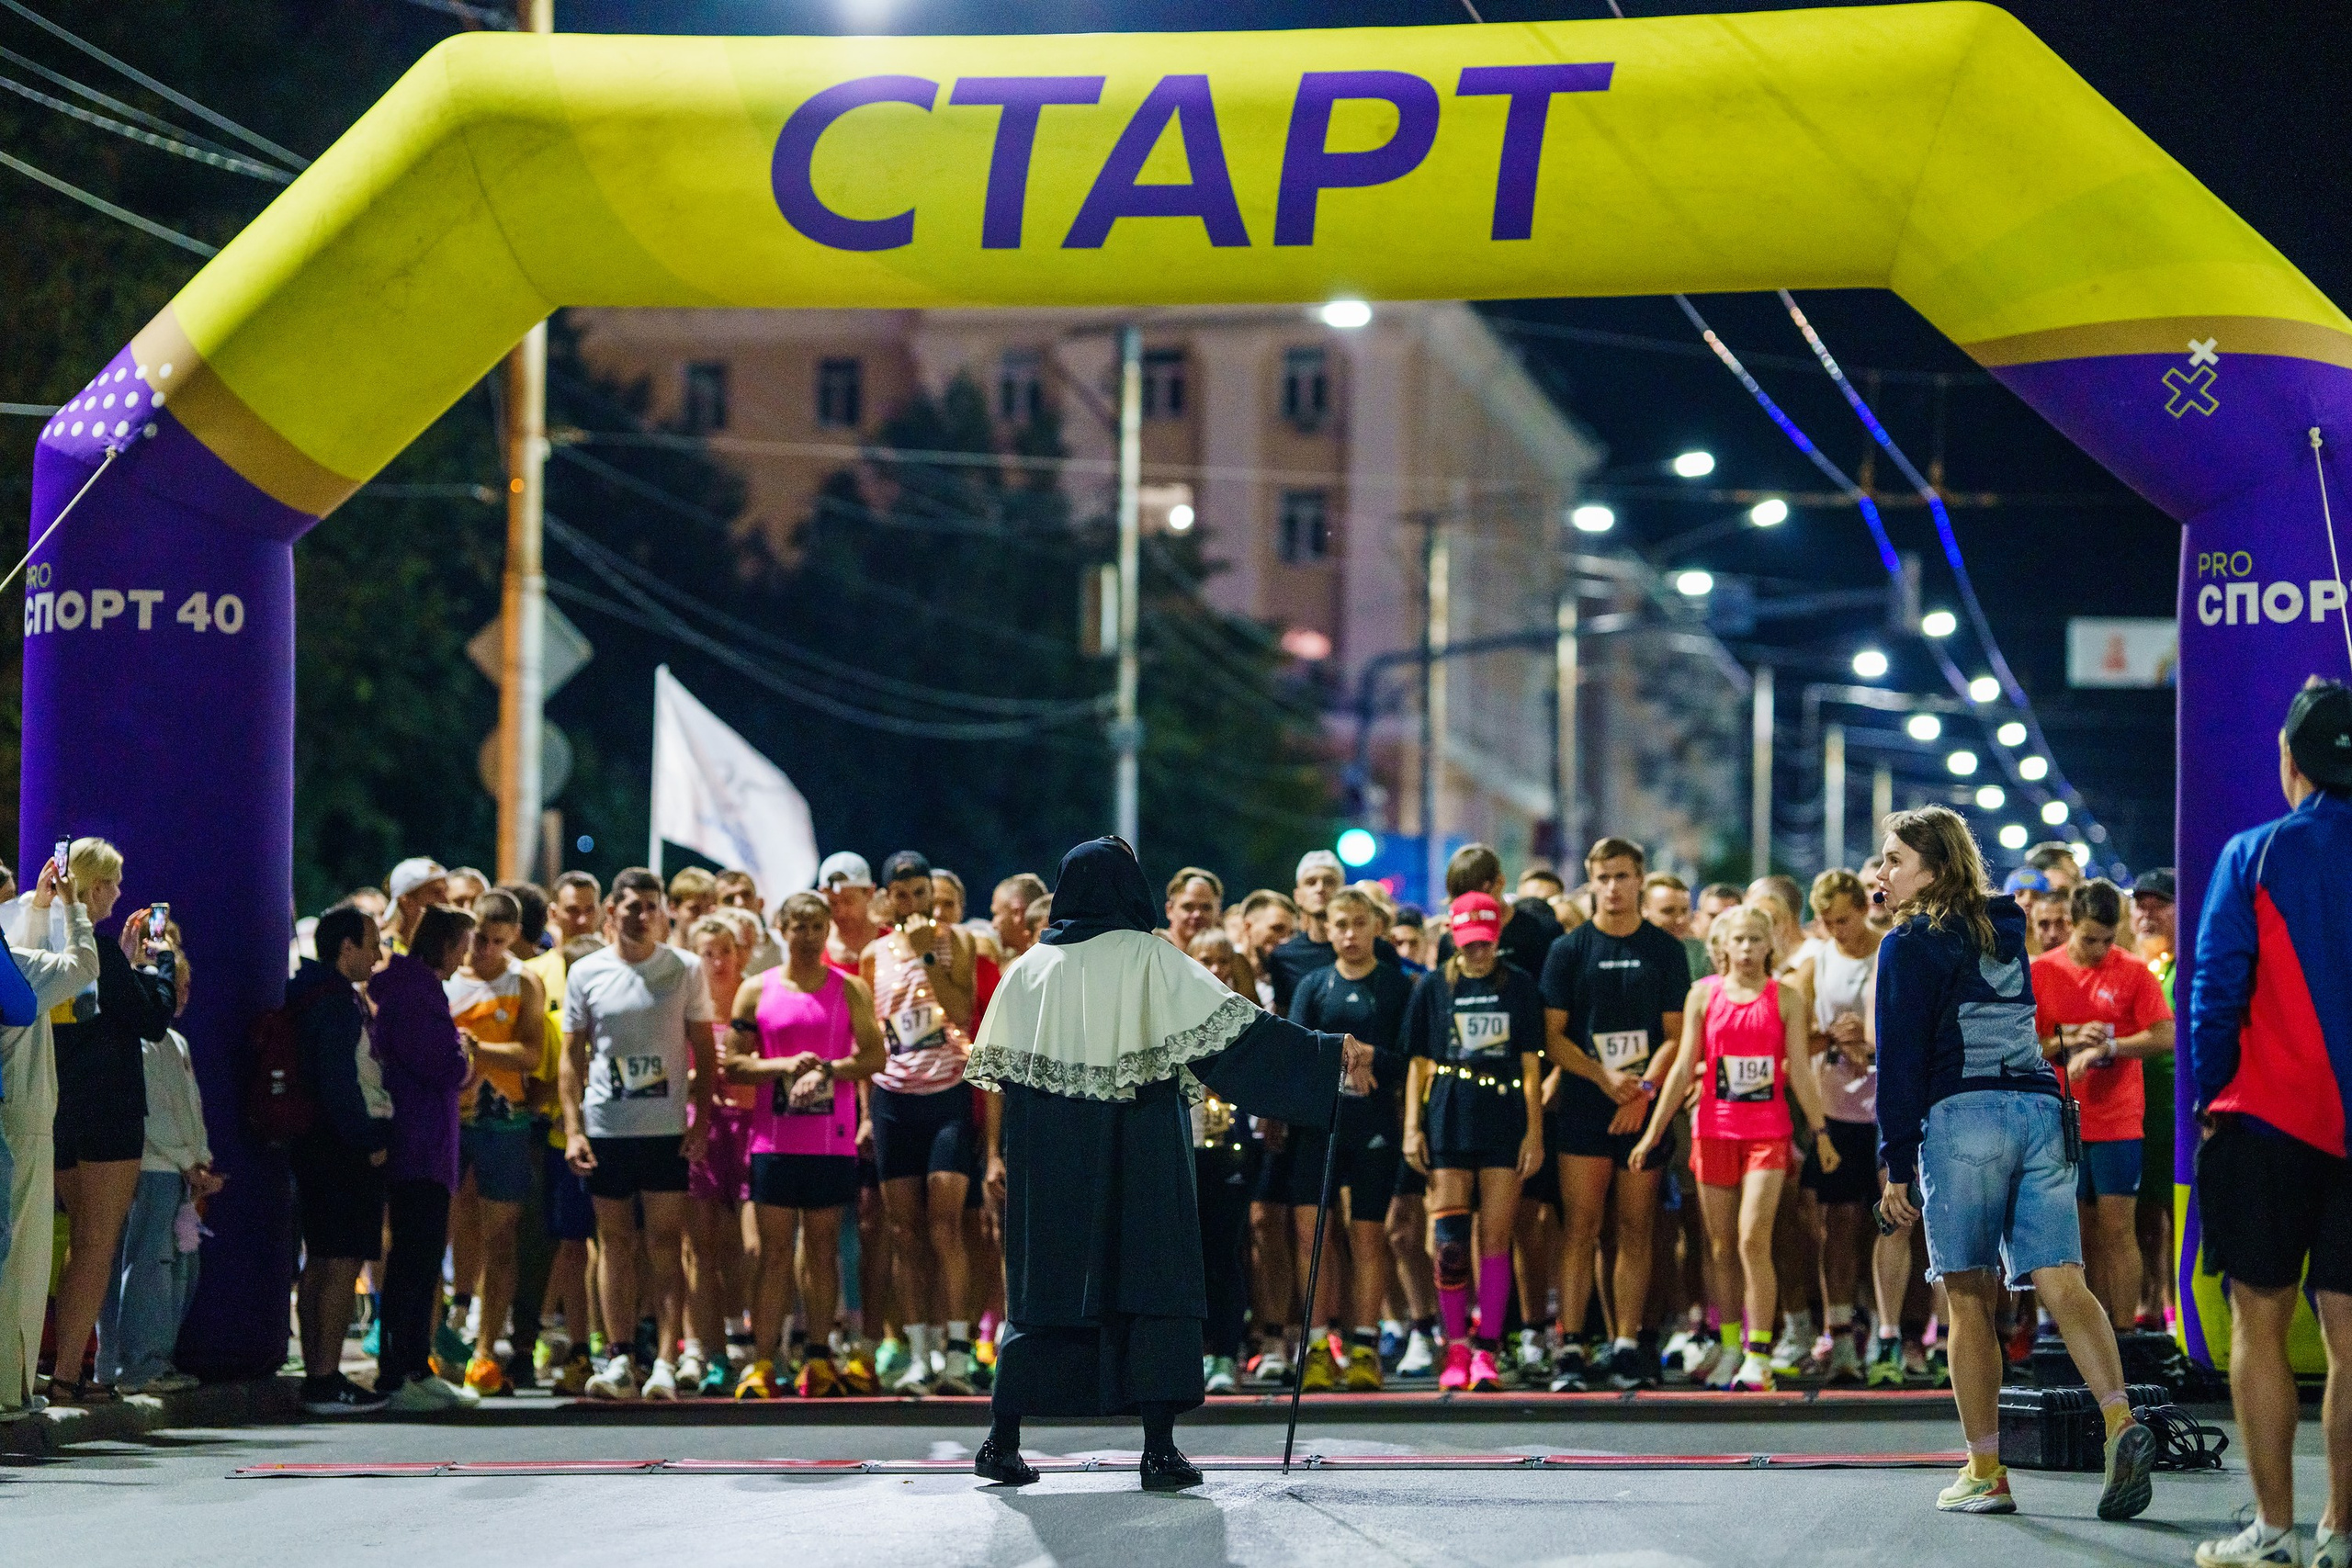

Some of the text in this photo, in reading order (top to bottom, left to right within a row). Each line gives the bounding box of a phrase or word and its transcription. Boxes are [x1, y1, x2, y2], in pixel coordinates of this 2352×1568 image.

[770, 61, 1615, 254] СТАРТ
[2198, 550, 2253, 579] PRO
[24, 589, 244, 637] СПОРТ 40
[2198, 579, 2352, 626] СПОР
[900, 1006, 932, 1032] 577
[1467, 1015, 1503, 1036] 570
[1606, 1035, 1640, 1056] 571
[1738, 1061, 1769, 1079] 194
